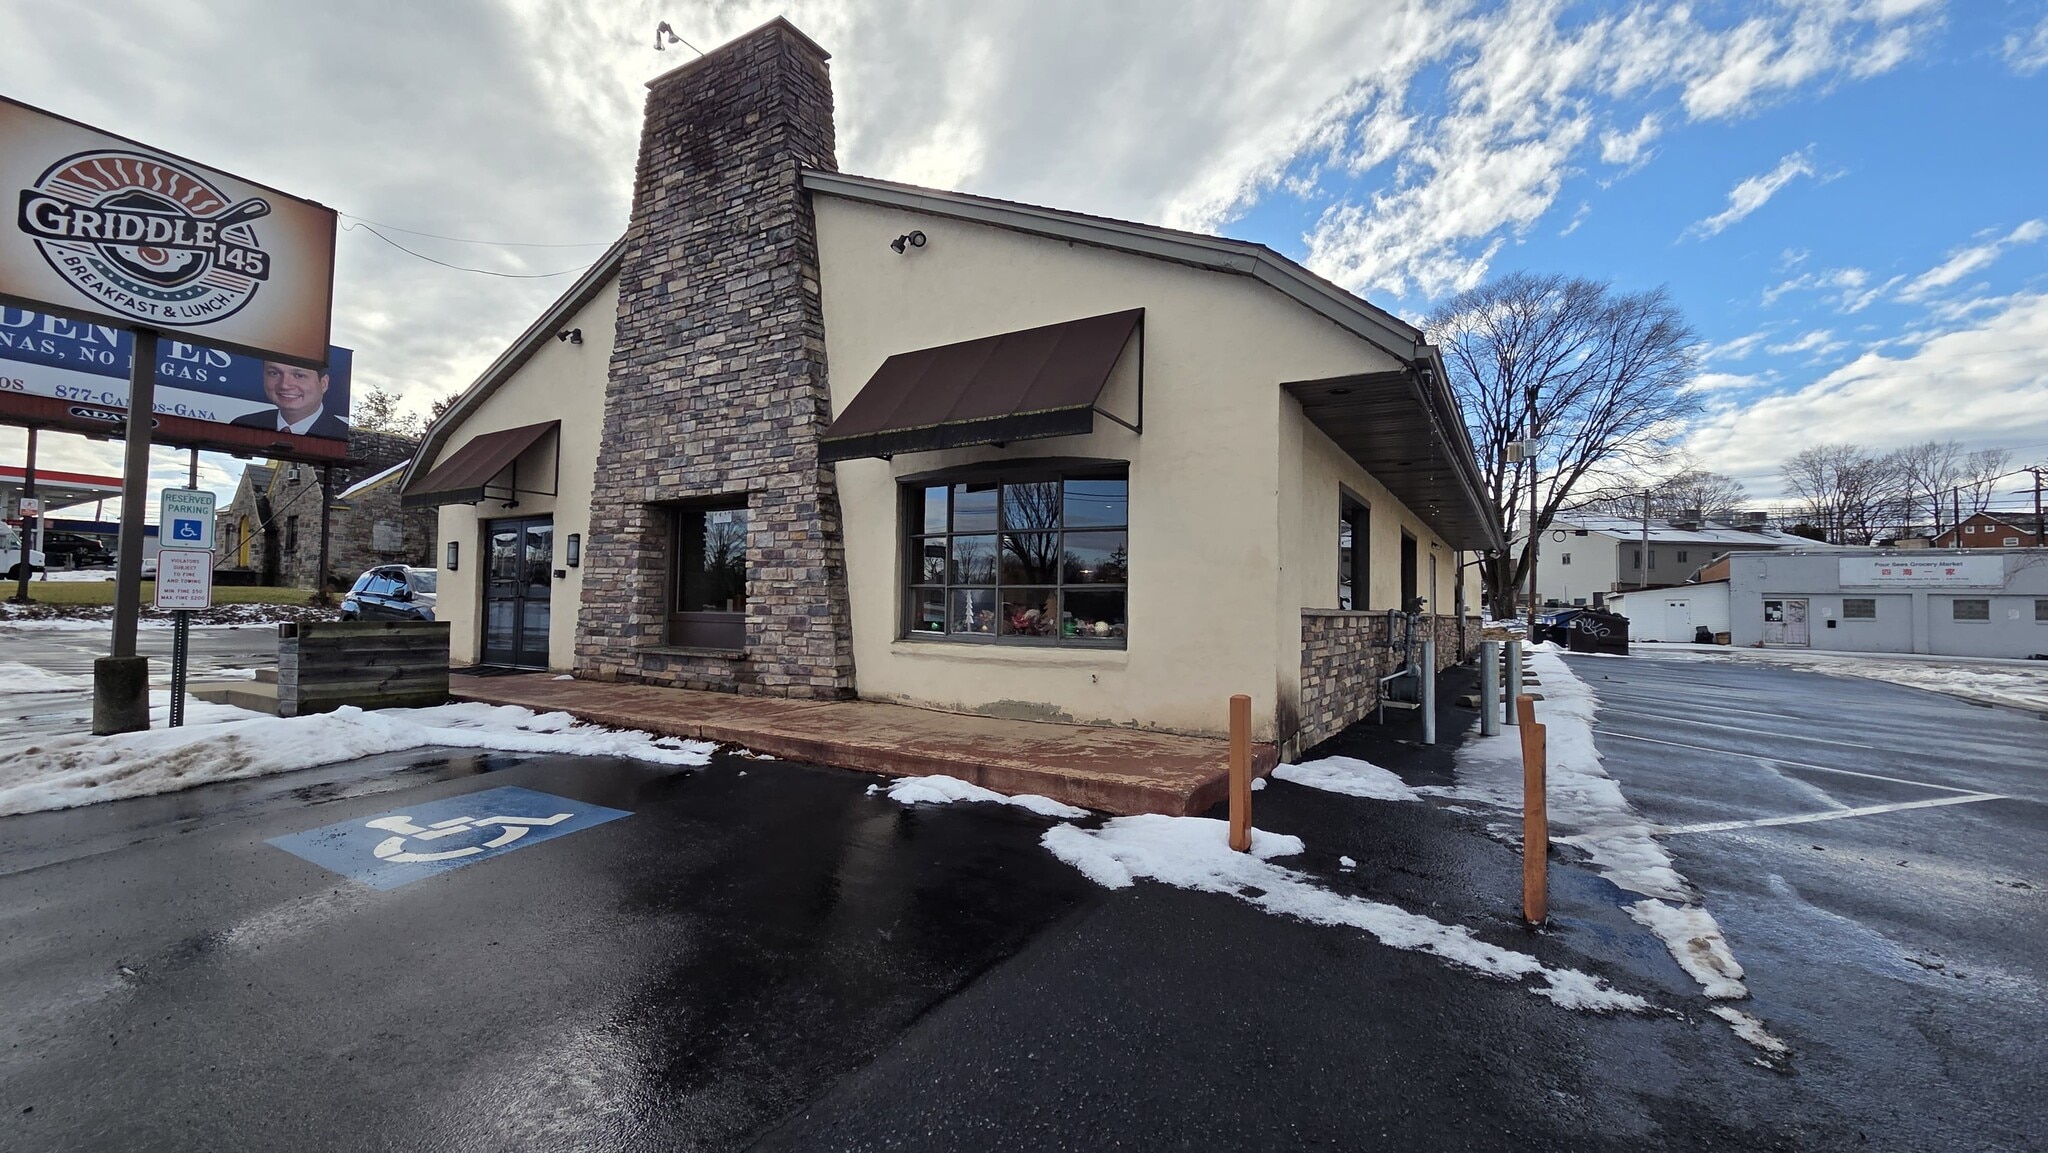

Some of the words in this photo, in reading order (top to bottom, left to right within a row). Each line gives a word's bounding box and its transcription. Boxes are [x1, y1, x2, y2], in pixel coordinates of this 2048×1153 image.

[25, 197, 217, 249] GRIDDLE
[218, 243, 264, 275] 145
[62, 256, 159, 316] BREAKFAST
[163, 306, 177, 318] &
[180, 294, 231, 318] LUNCH
[78, 346, 115, 365] NO
[127, 355, 208, 383] GAS
[165, 493, 212, 506] RESERVED
[168, 503, 209, 515] PARKING
